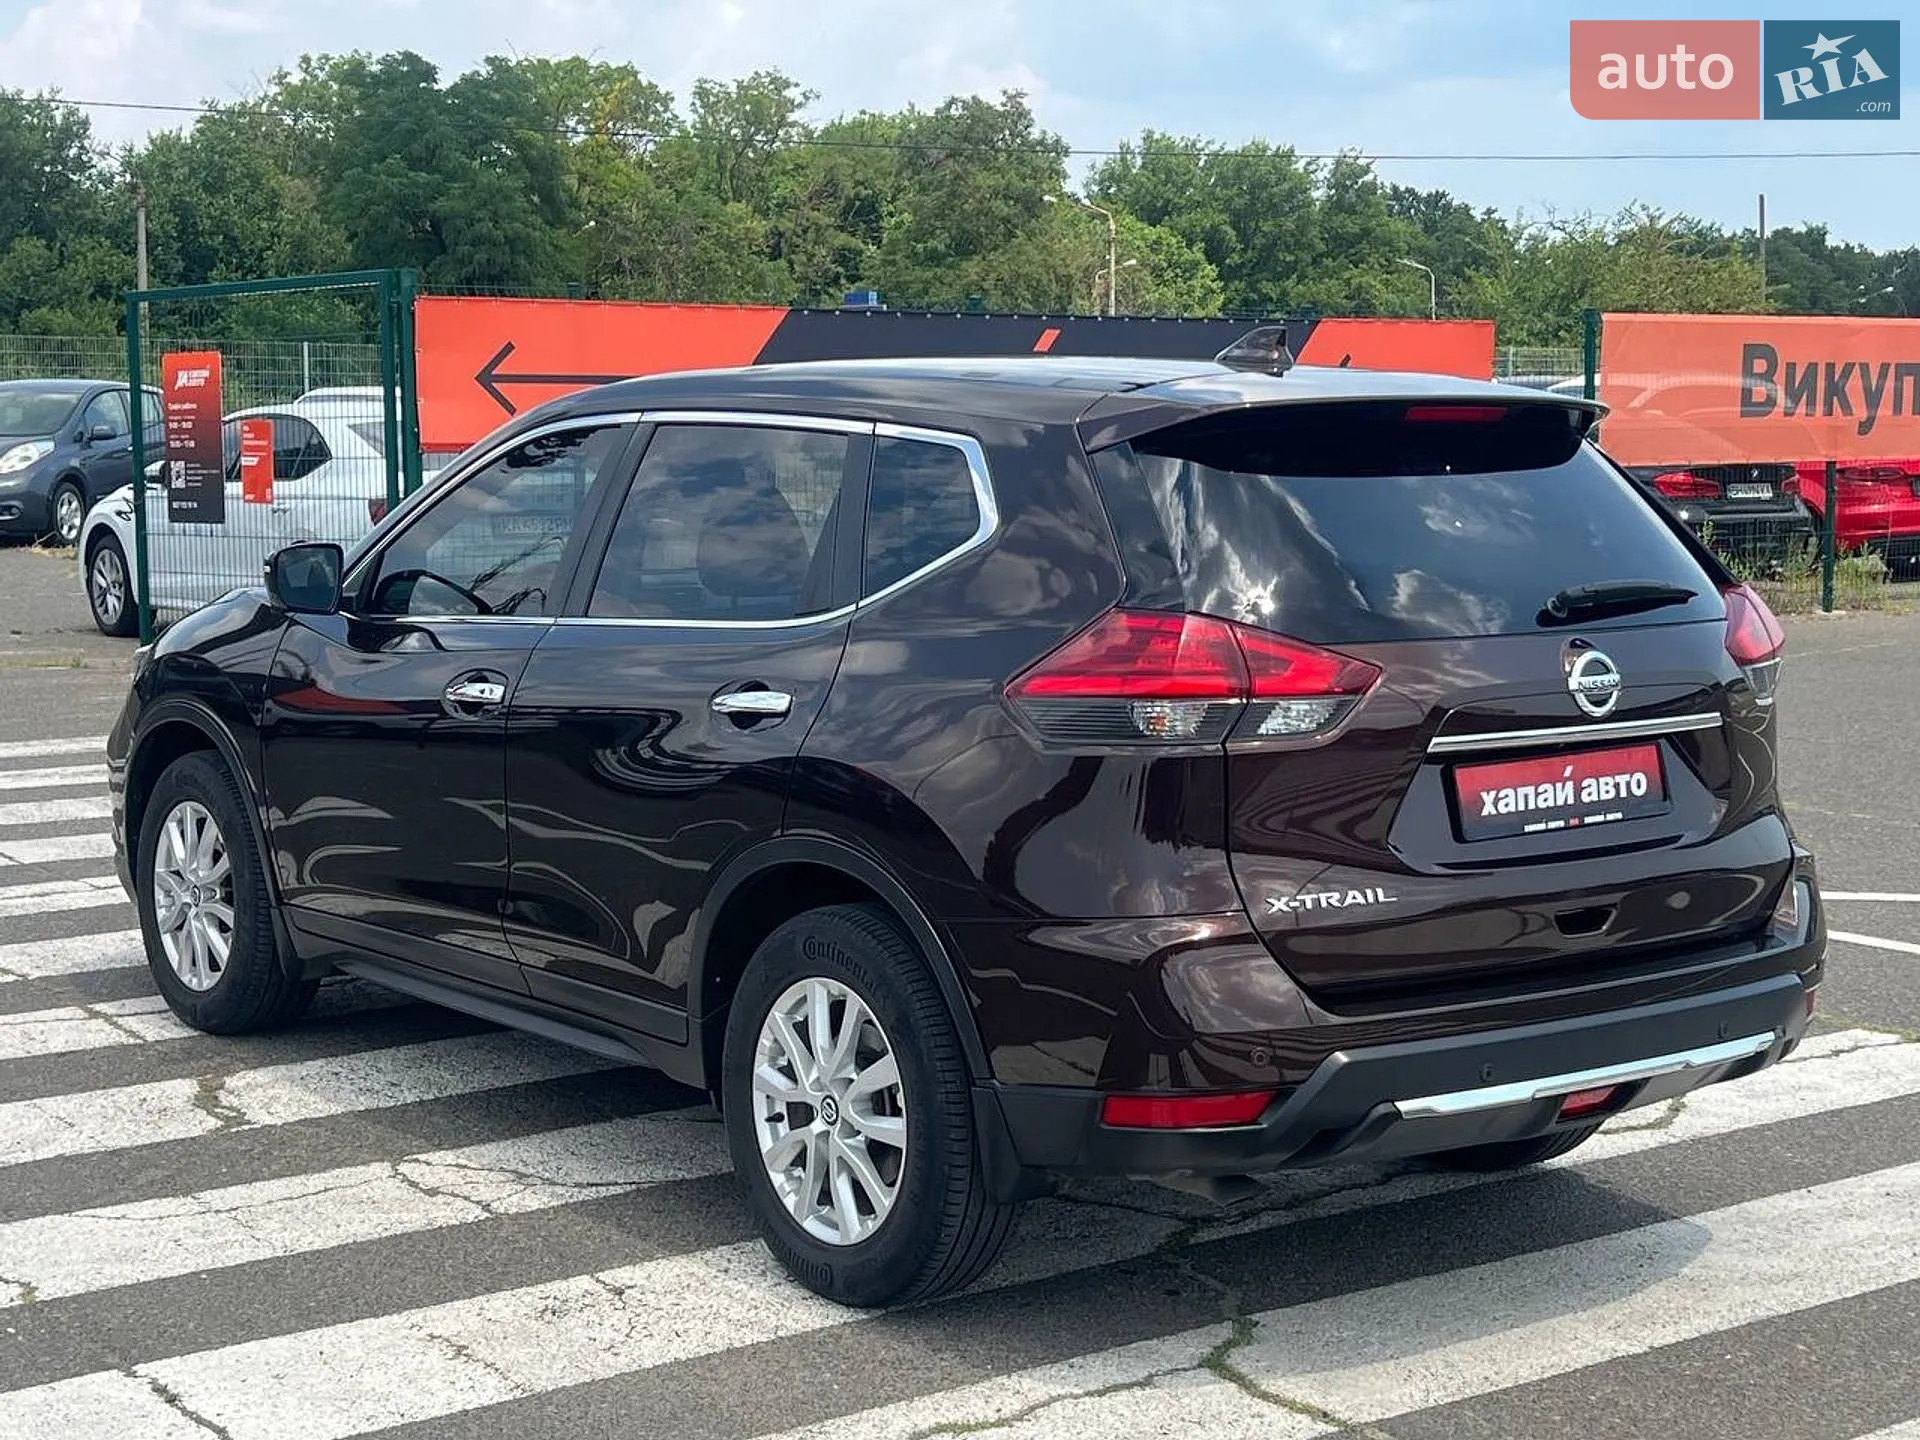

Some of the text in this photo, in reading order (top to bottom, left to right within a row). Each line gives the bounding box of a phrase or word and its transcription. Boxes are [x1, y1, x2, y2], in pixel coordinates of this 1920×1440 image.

[1740, 343, 1920, 436] Викуп
[1575, 678, 1619, 692] NISSAN
[1580, 772, 1648, 804] авто
[1264, 887, 1399, 915] X-TRAIL
[802, 935, 877, 998] Continental
